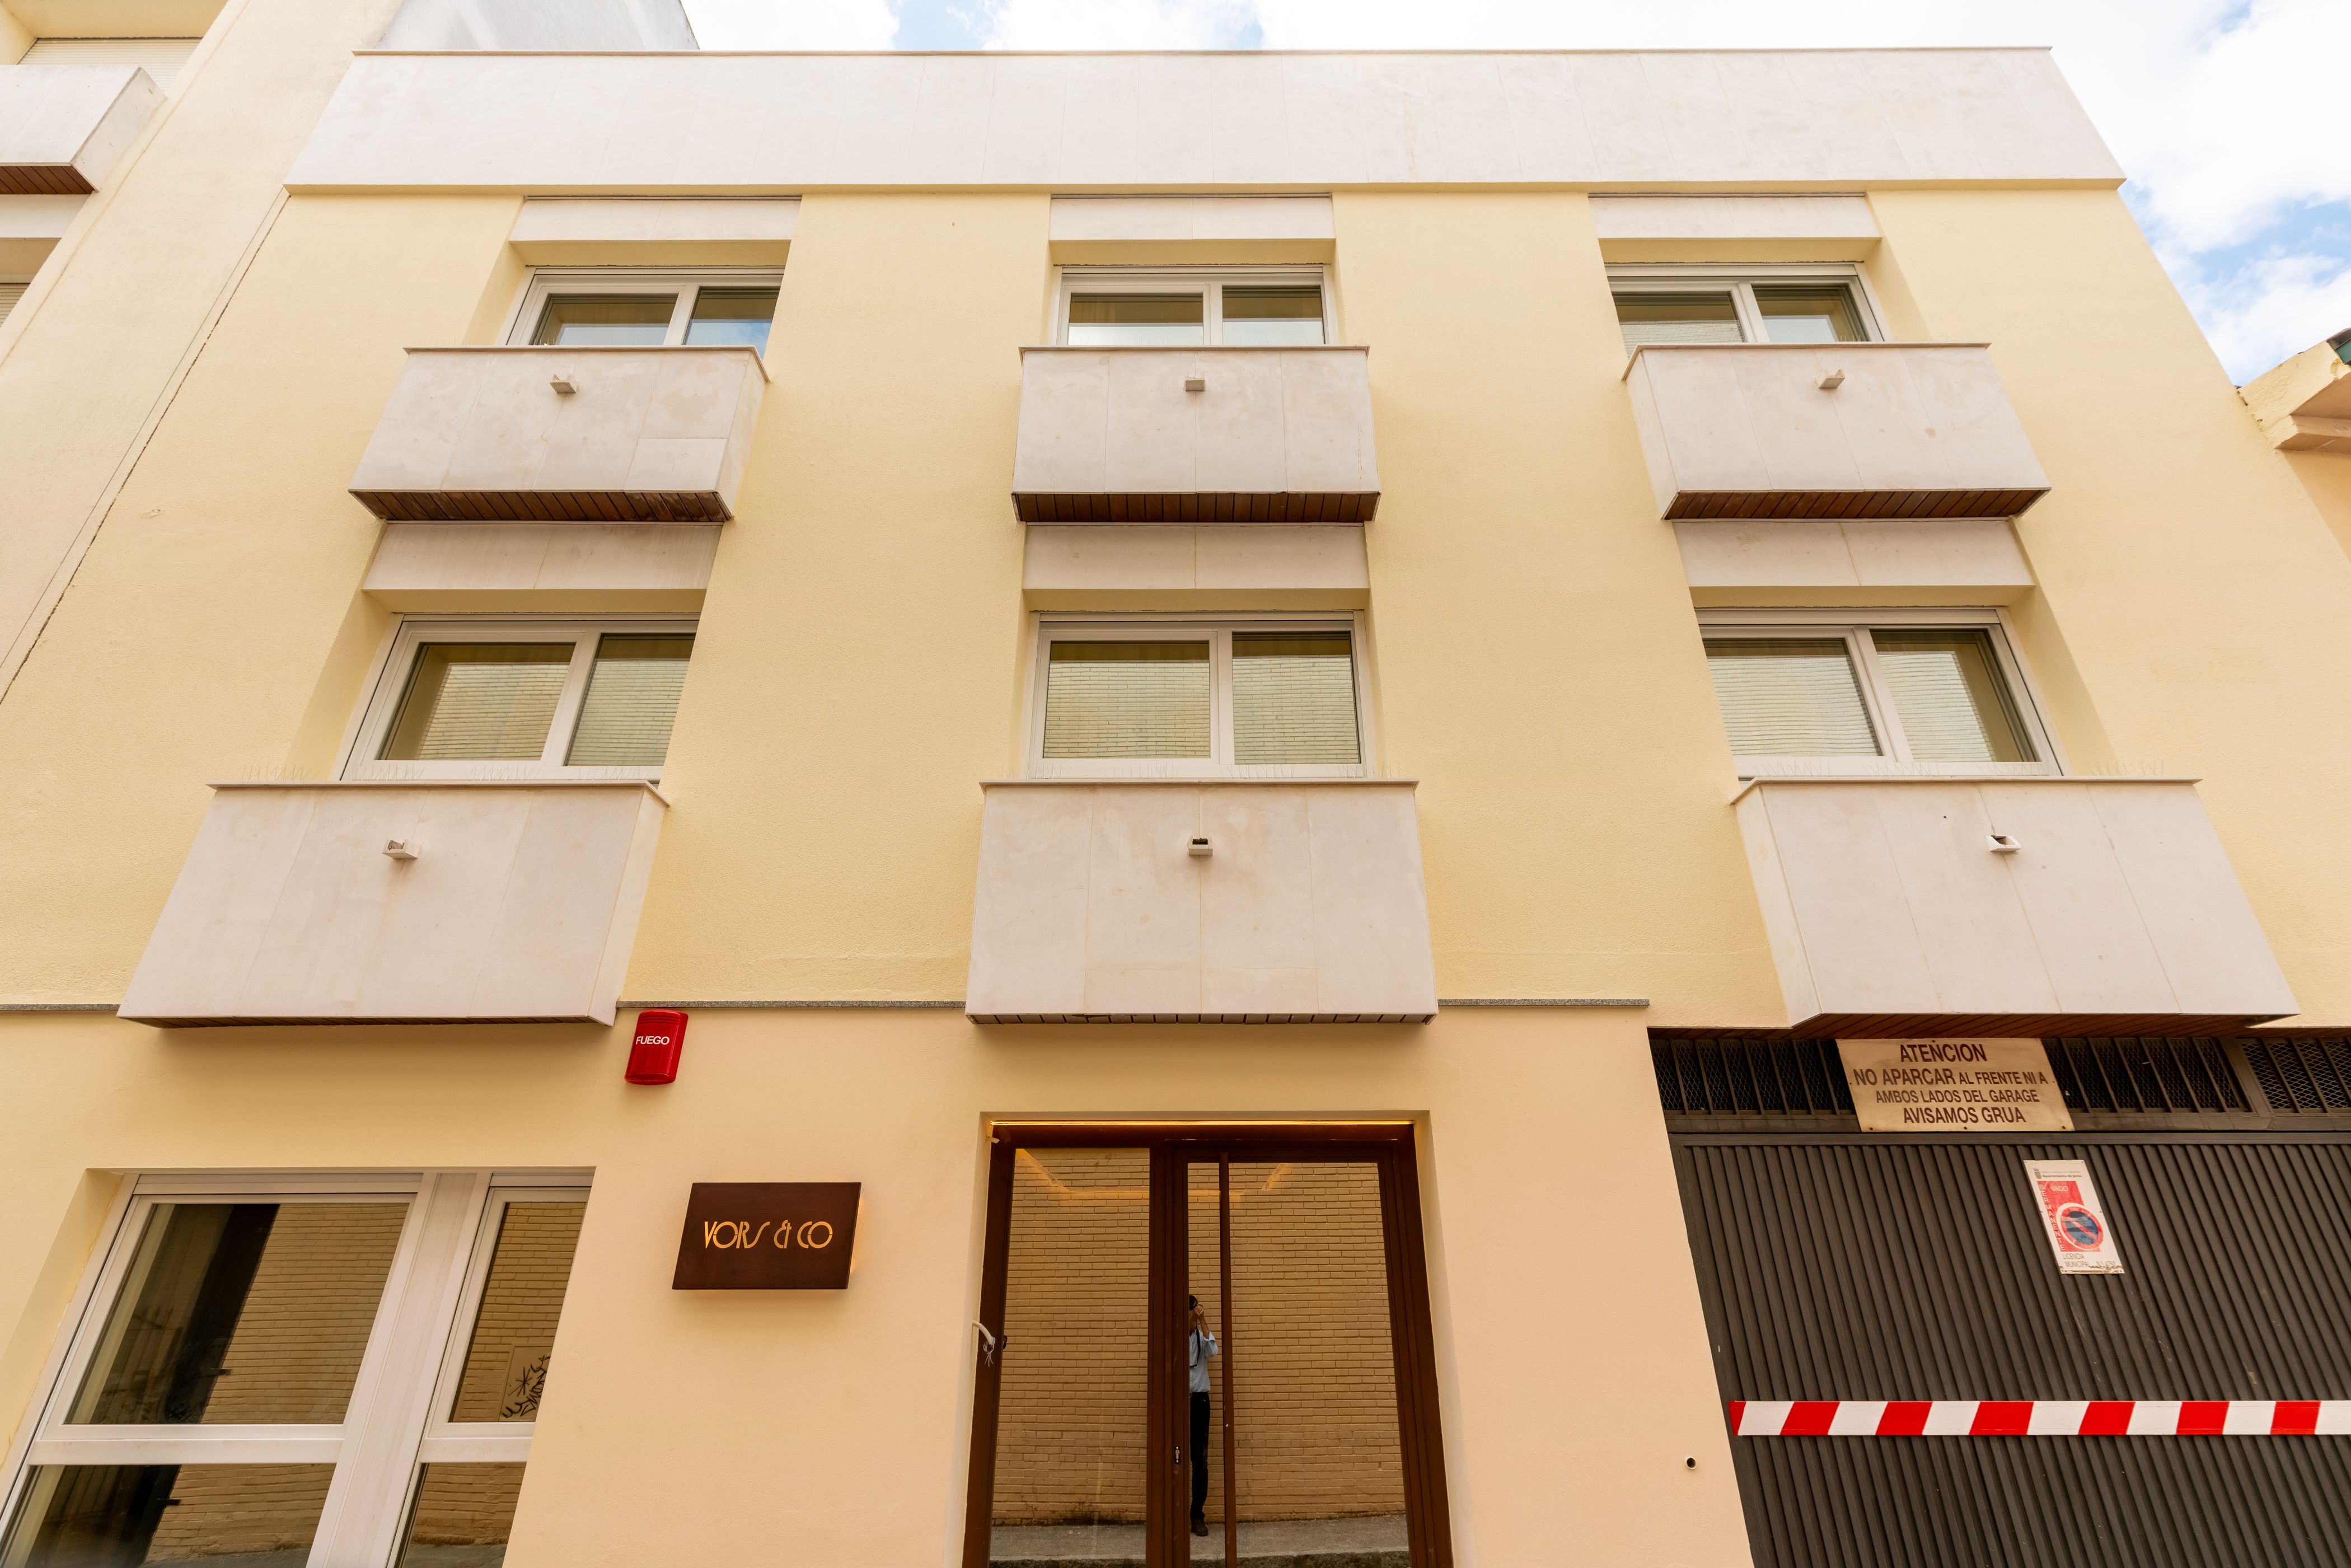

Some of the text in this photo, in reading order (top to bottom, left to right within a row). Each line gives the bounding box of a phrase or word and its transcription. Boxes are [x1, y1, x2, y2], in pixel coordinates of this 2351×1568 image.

[635, 1036, 670, 1045] FUEGO
[1900, 1043, 1988, 1063] ATENCION
[1853, 1068, 2049, 1085] NO APARCAR AL FRENTE NI A
[1876, 1089, 2040, 1103] AMBOS LADOS DEL GARAGE
[1904, 1106, 2026, 1124] AVISAMOS GRUA
[2039, 1184, 2066, 1251] PERMANENTE
[704, 1219, 833, 1249] VORS & CO
